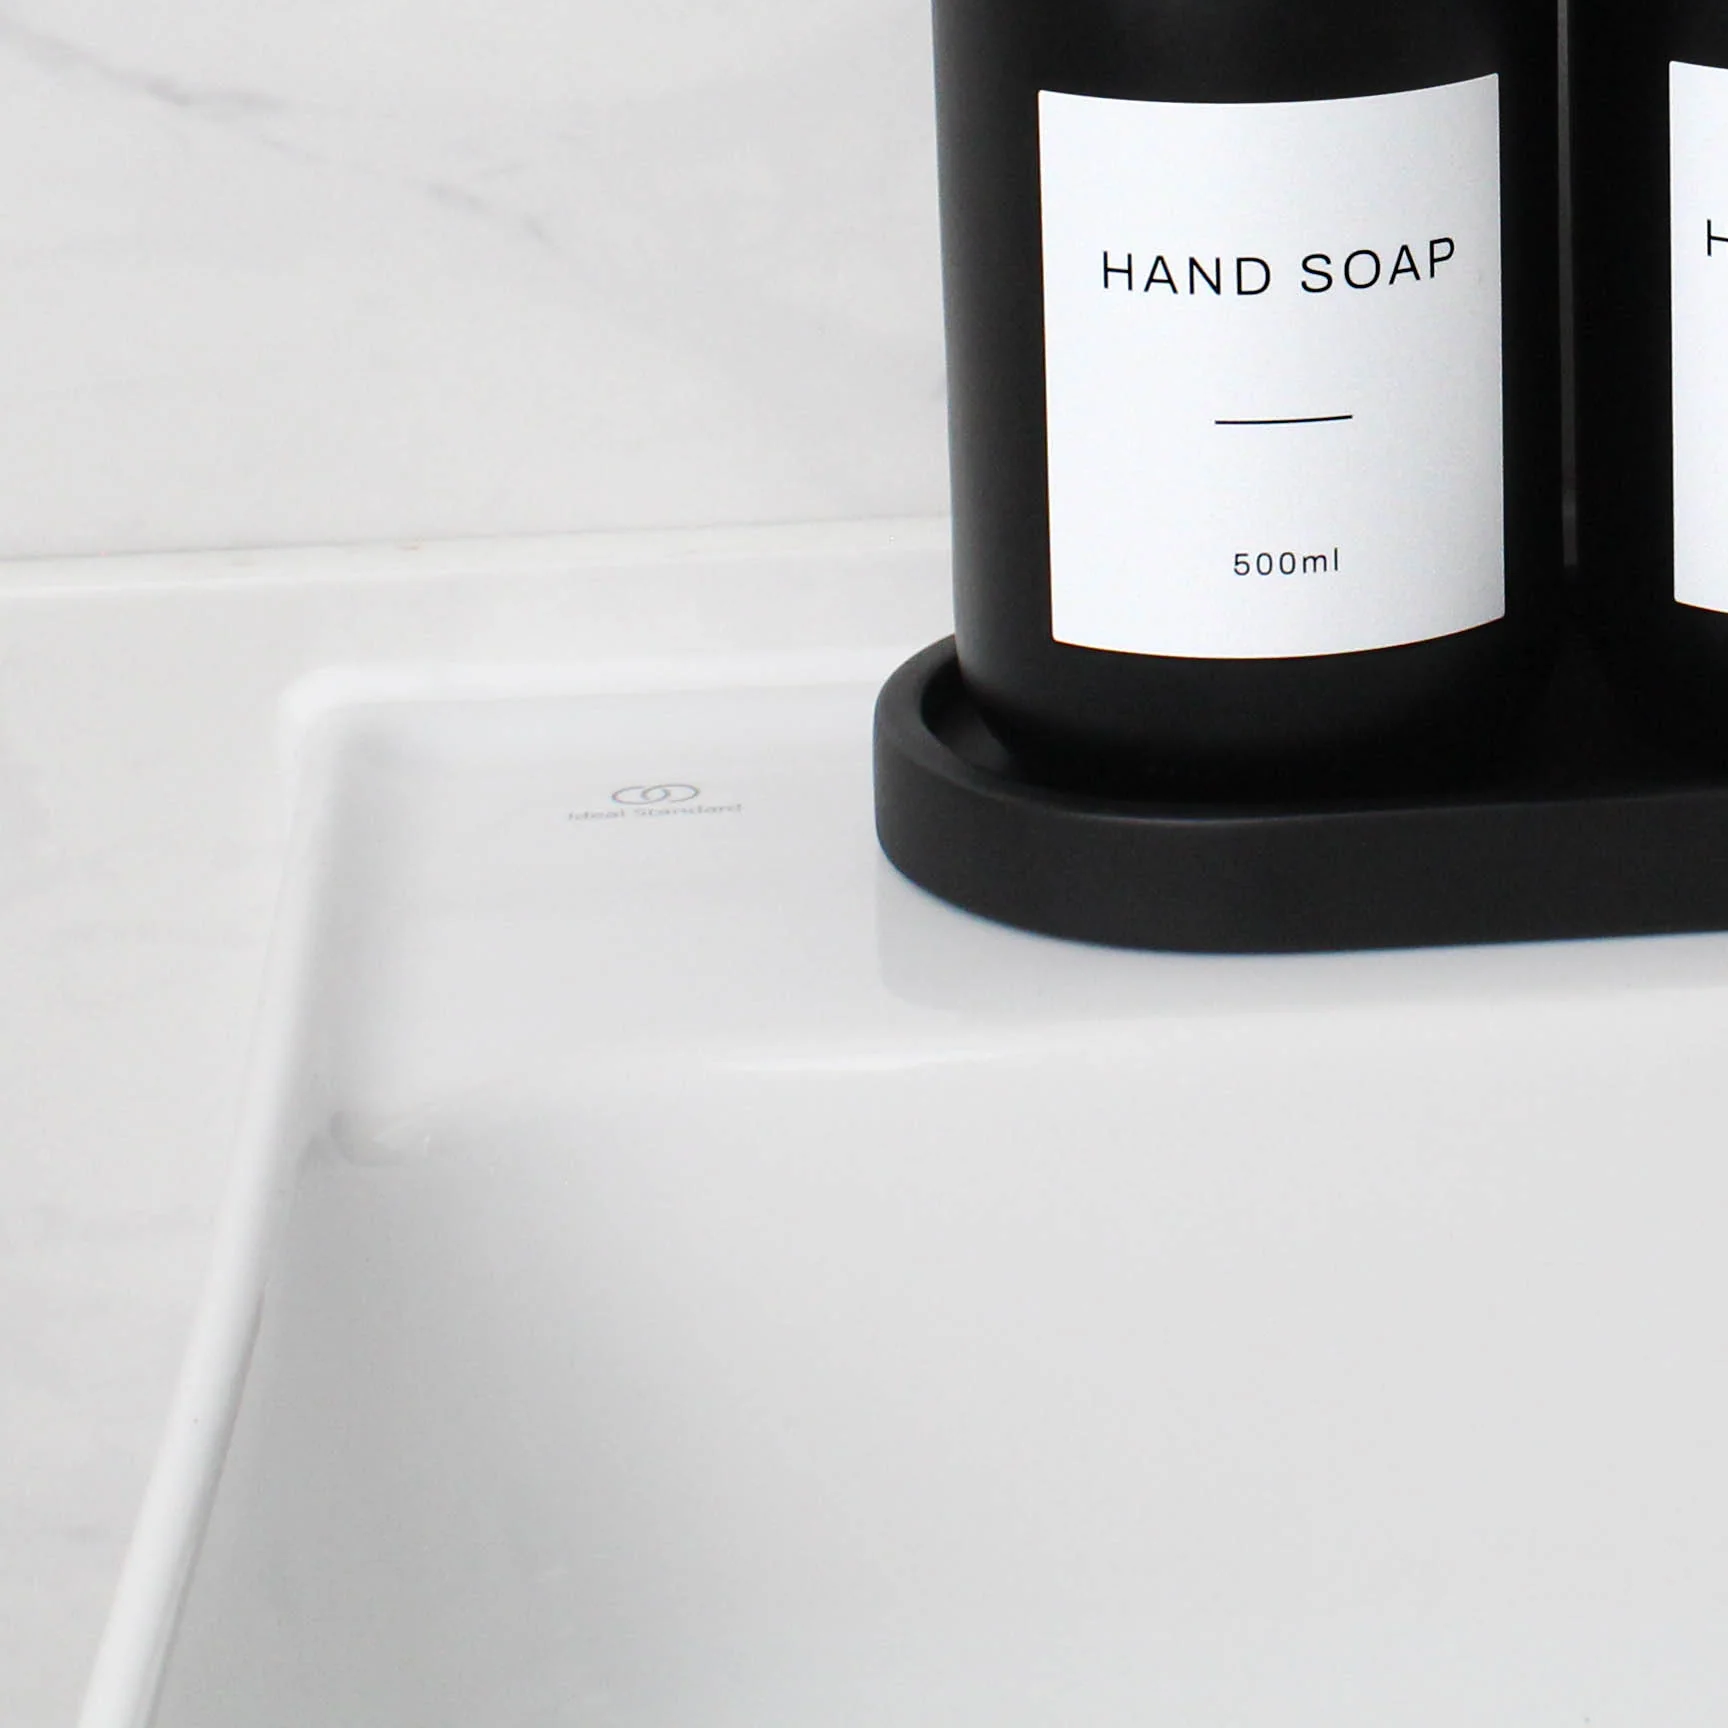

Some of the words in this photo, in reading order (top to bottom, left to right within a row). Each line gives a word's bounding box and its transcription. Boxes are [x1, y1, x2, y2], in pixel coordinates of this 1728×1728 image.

[1102, 250, 1272, 296] HAND
[1300, 236, 1456, 294] SOAP
[1232, 547, 1340, 576] 500ml
